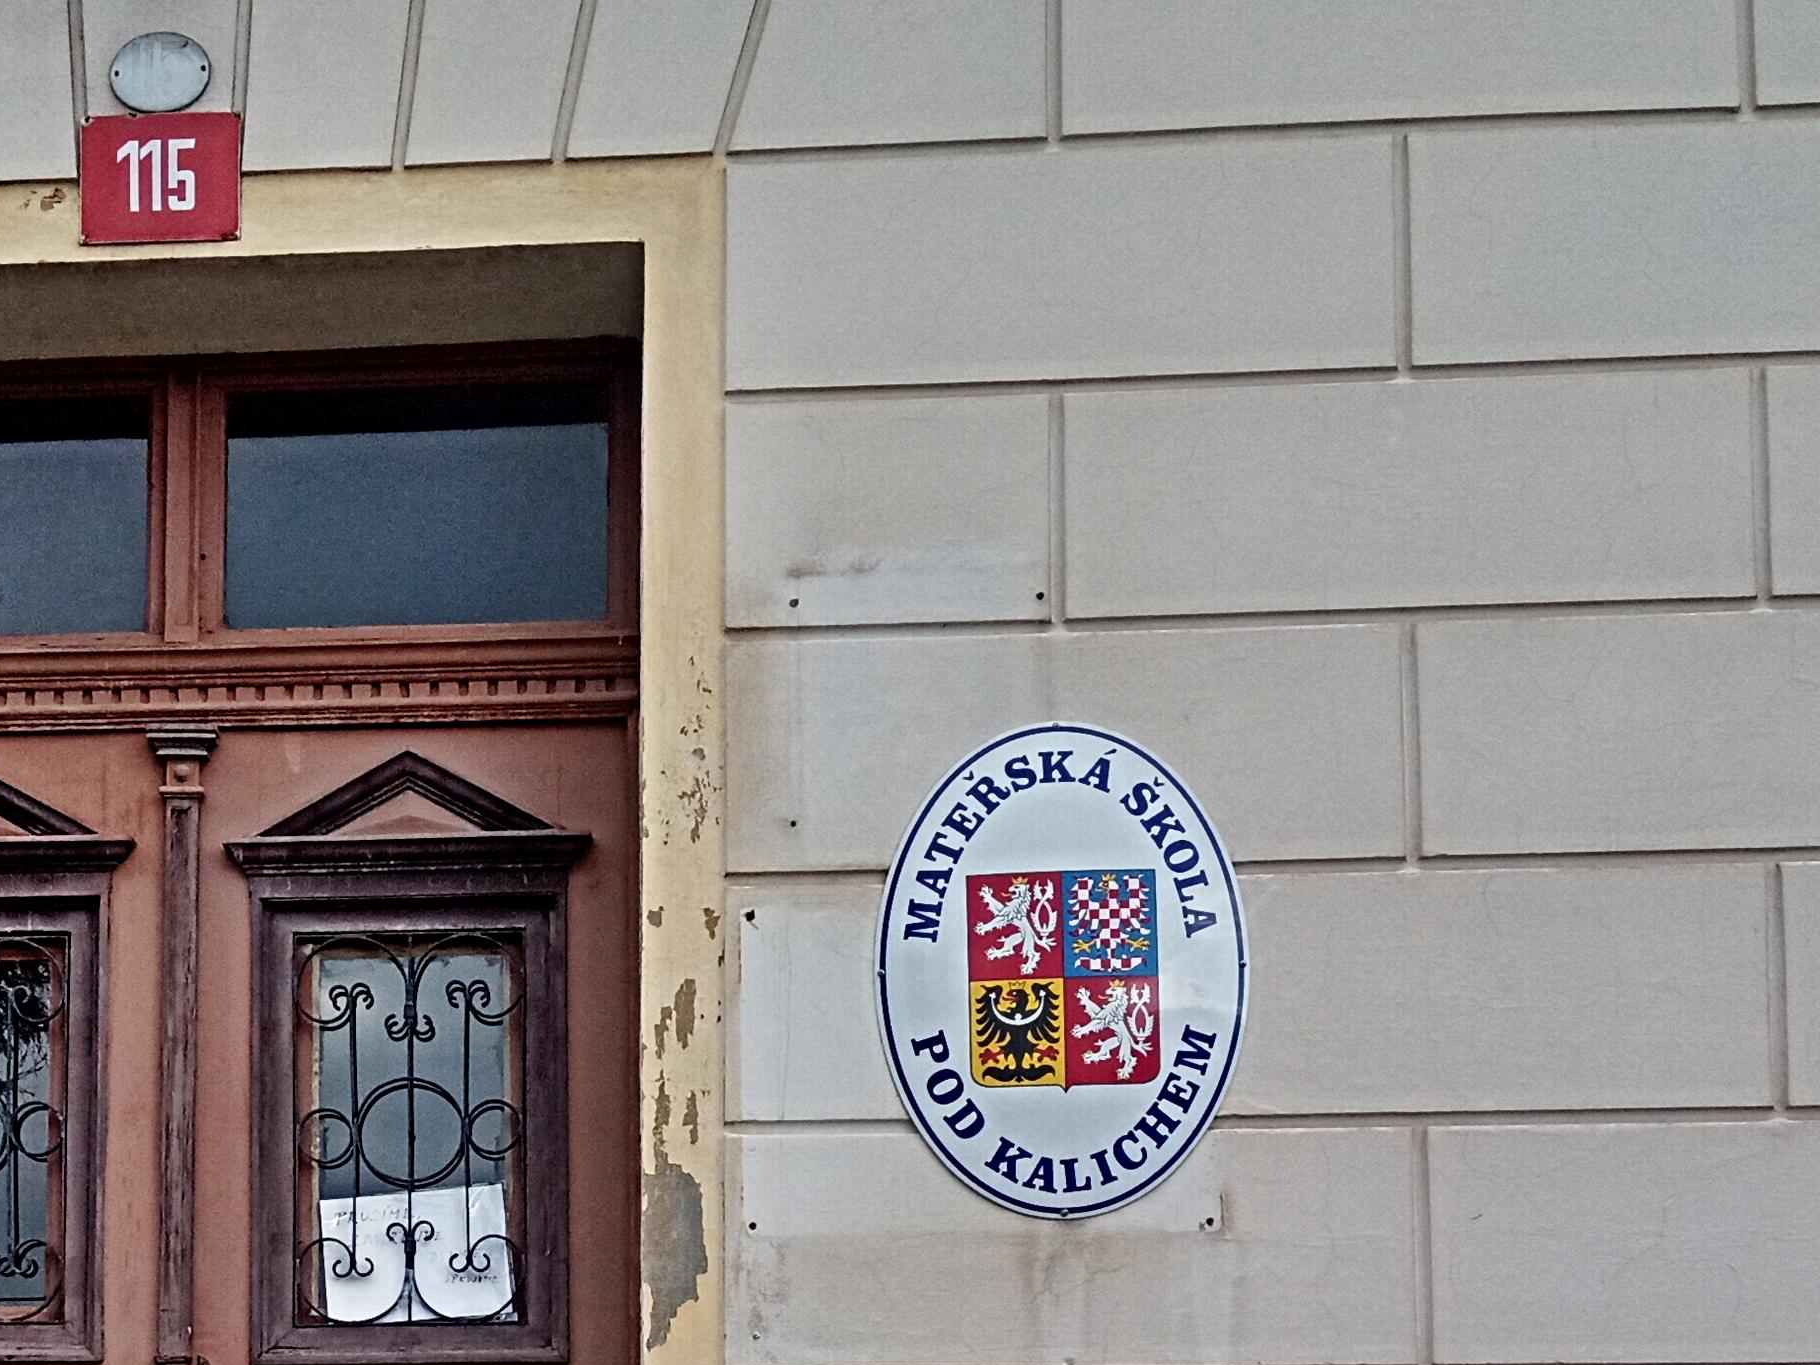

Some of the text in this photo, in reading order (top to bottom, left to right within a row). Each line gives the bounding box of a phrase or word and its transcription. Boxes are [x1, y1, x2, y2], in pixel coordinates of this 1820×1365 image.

[116, 138, 196, 212] 115
[903, 748, 1218, 944] MATEŘSKÁ ŠKOLA
[911, 1024, 1218, 1195] POD KALICHEM
